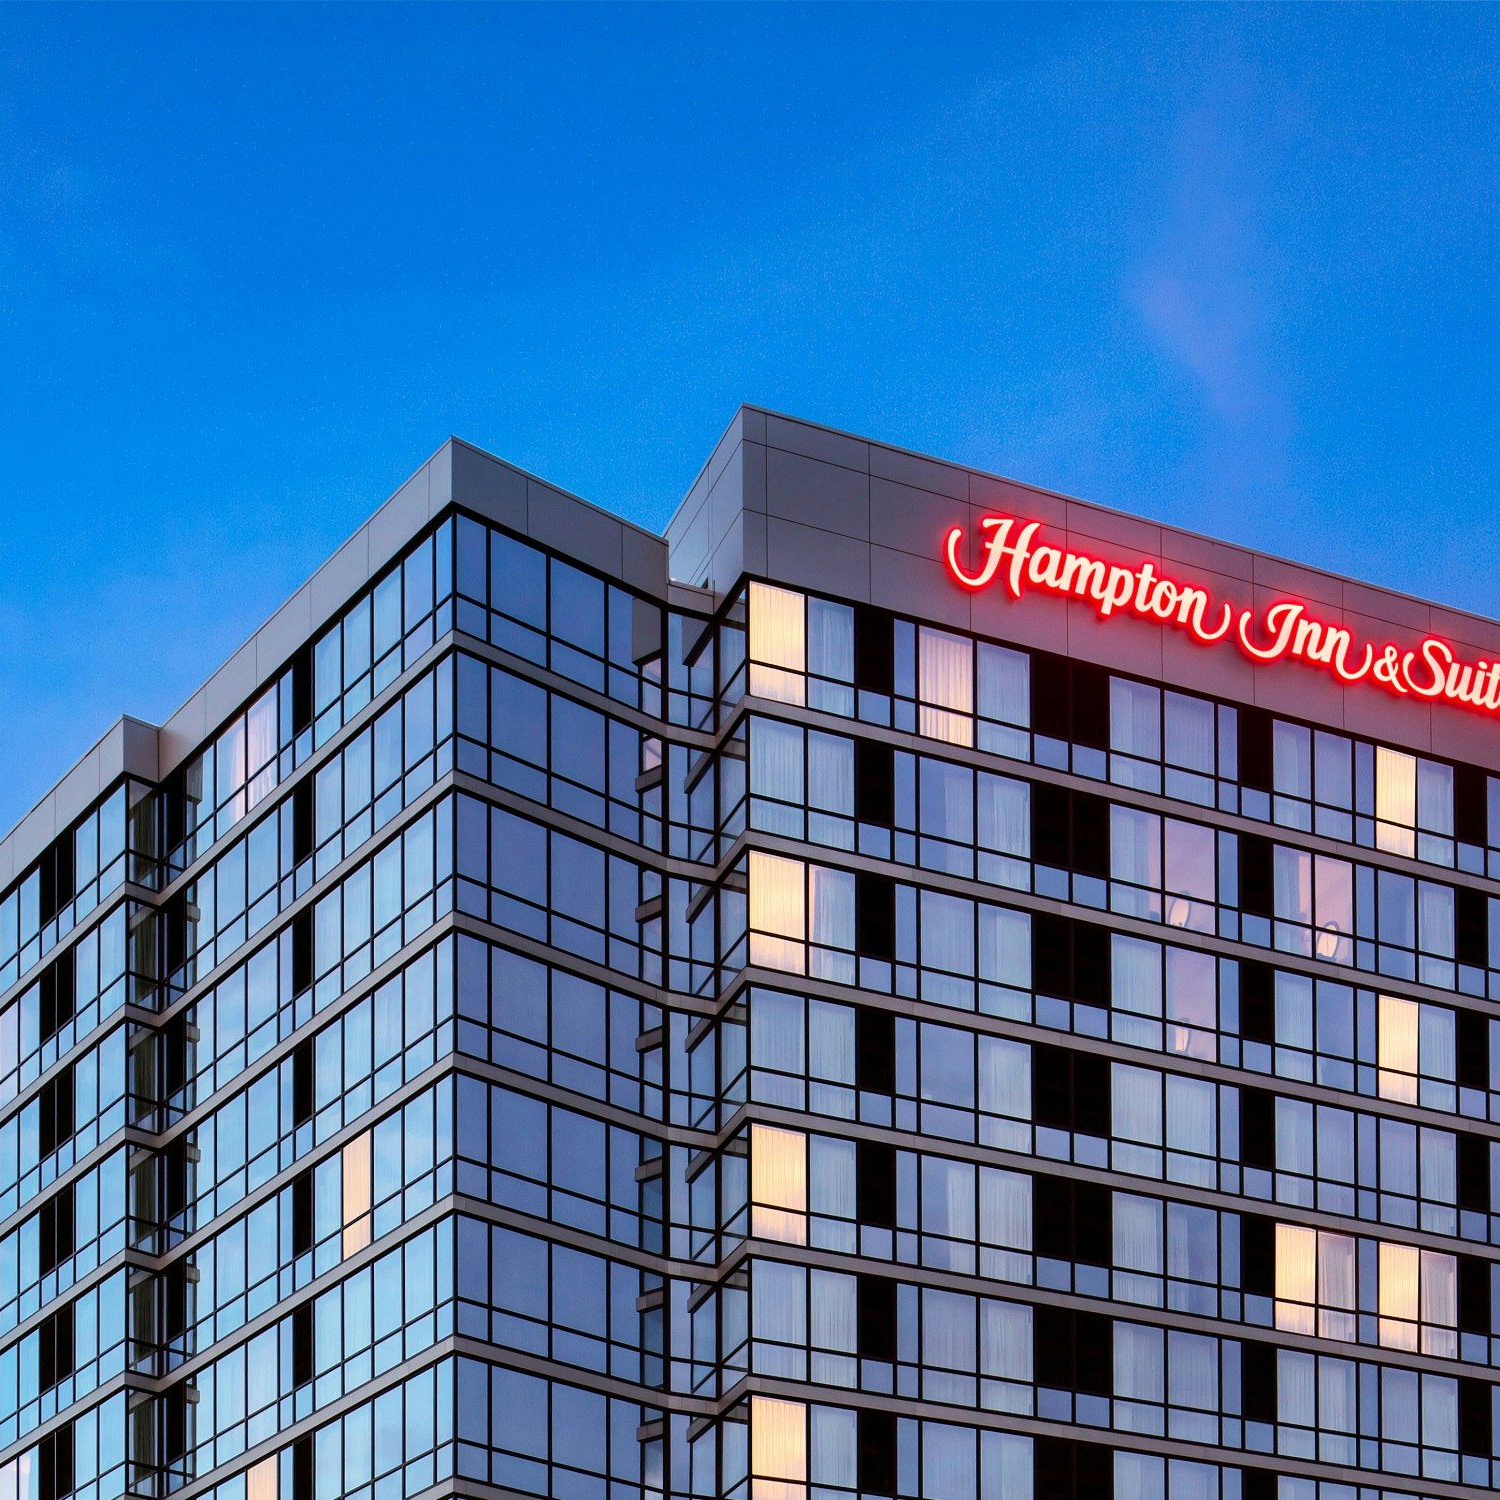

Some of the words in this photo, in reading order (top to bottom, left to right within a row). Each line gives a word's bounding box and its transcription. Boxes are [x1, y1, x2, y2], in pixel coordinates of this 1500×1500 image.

[947, 517, 1230, 640] Hampton
[1239, 603, 1372, 680] Inn
[1373, 645, 1407, 693] &
